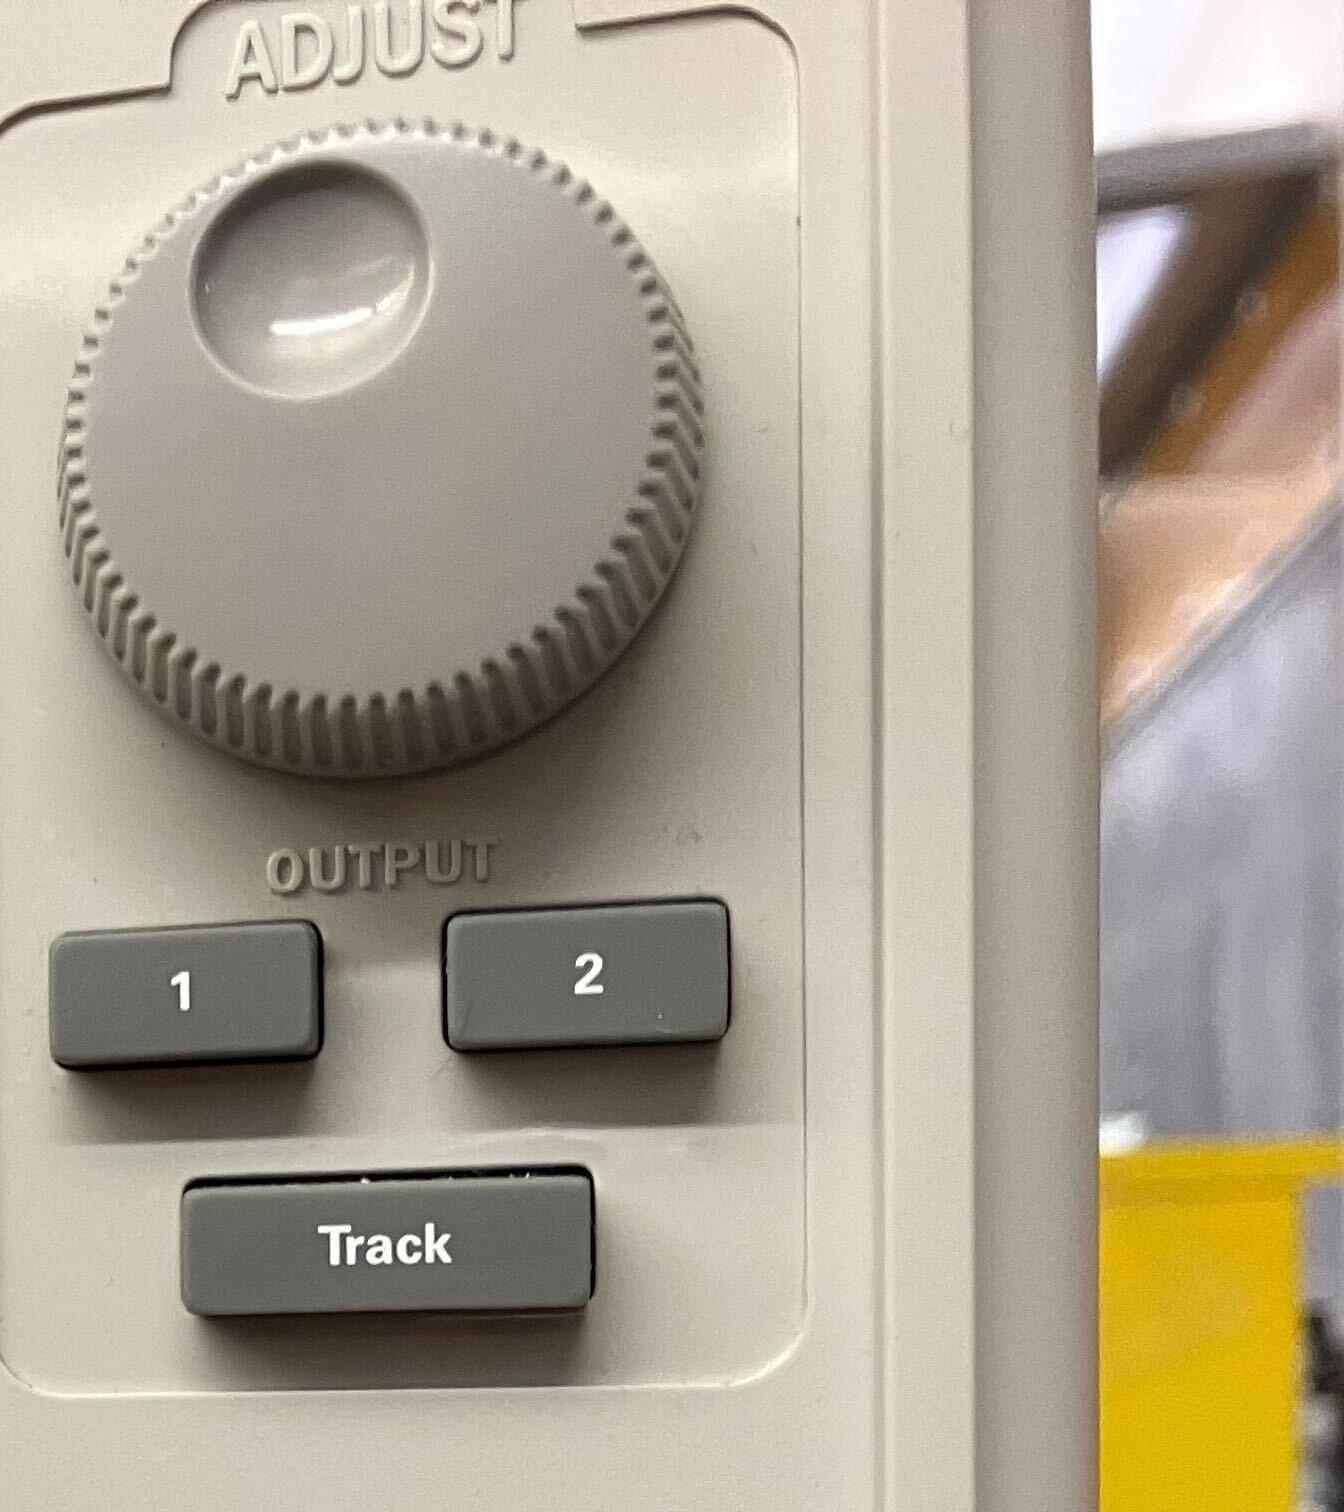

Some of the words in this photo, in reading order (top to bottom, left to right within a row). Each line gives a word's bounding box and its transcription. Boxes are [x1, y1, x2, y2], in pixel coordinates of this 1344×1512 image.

[224, 0, 515, 100] ADJUST
[266, 838, 497, 895] OUTPUT
[169, 970, 191, 1012] 1
[574, 953, 605, 996] 2
[317, 1222, 453, 1267] Track
